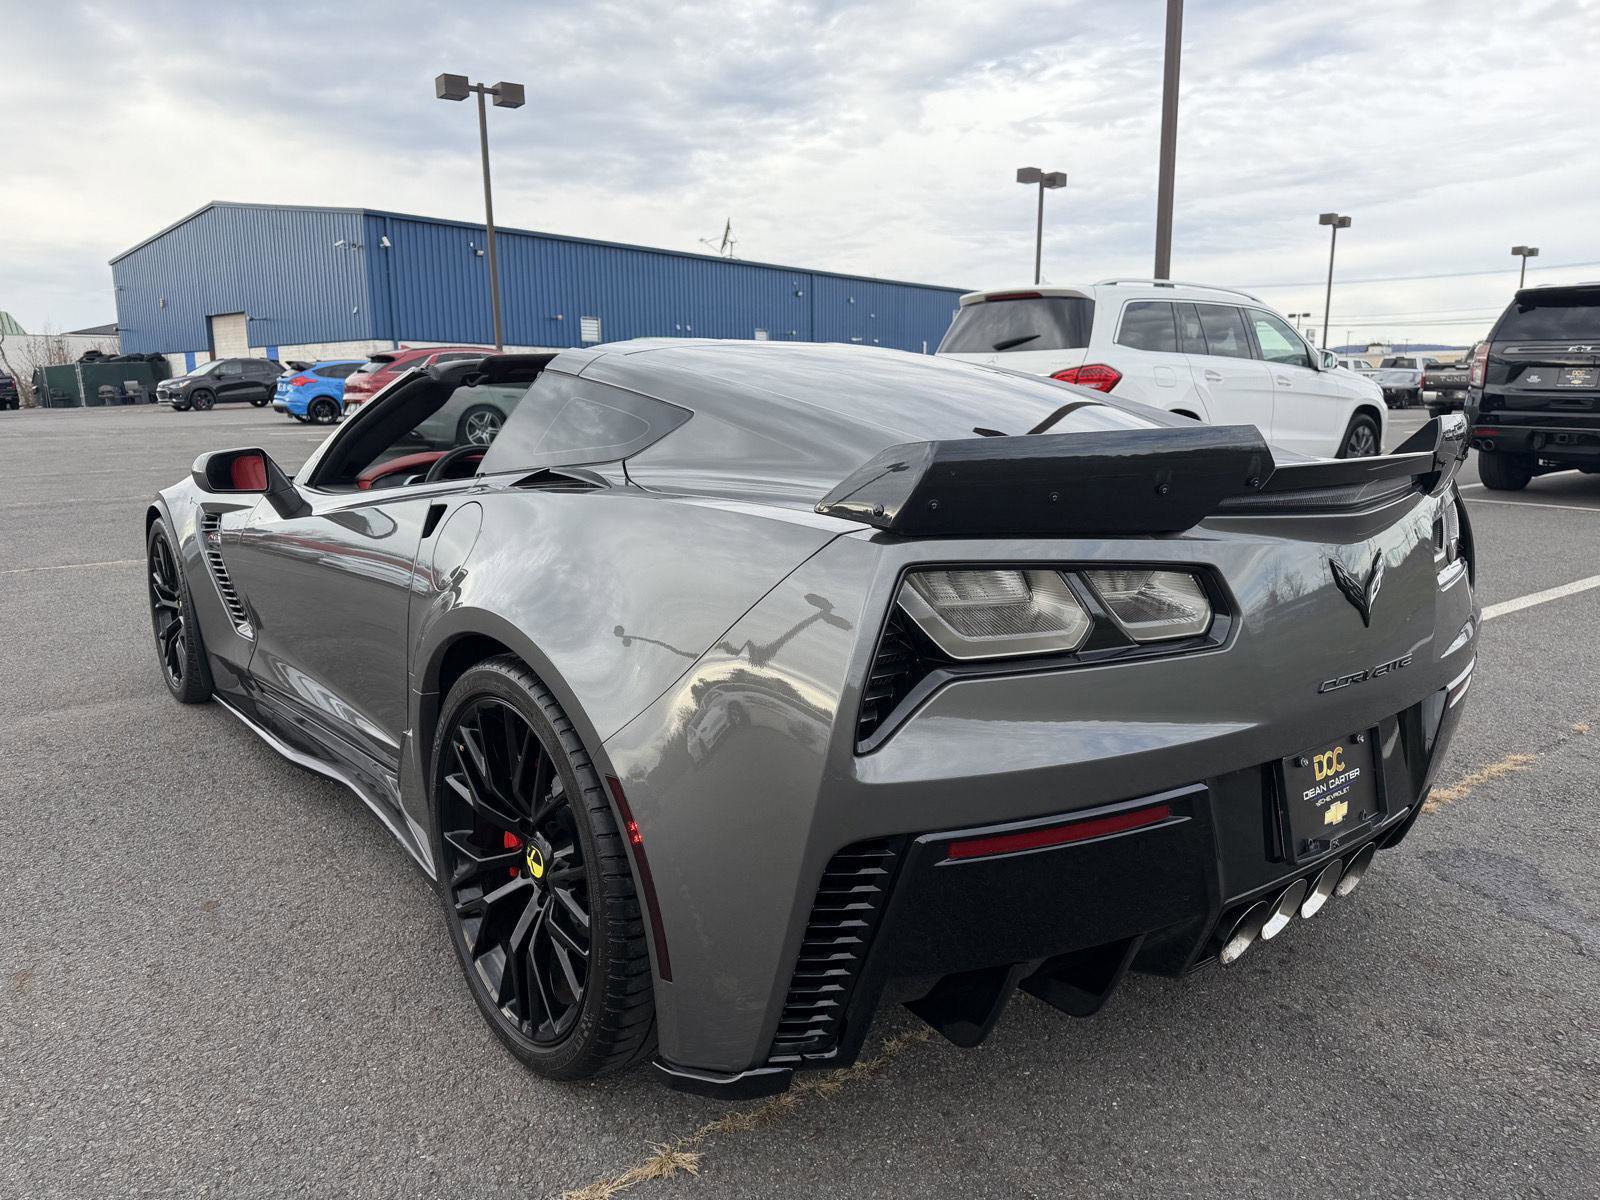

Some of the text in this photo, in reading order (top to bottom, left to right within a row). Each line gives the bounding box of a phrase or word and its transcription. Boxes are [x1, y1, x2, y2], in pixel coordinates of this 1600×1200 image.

[1318, 653, 1412, 693] CORVETTE
[1303, 768, 1360, 801] DEAN CARTER
